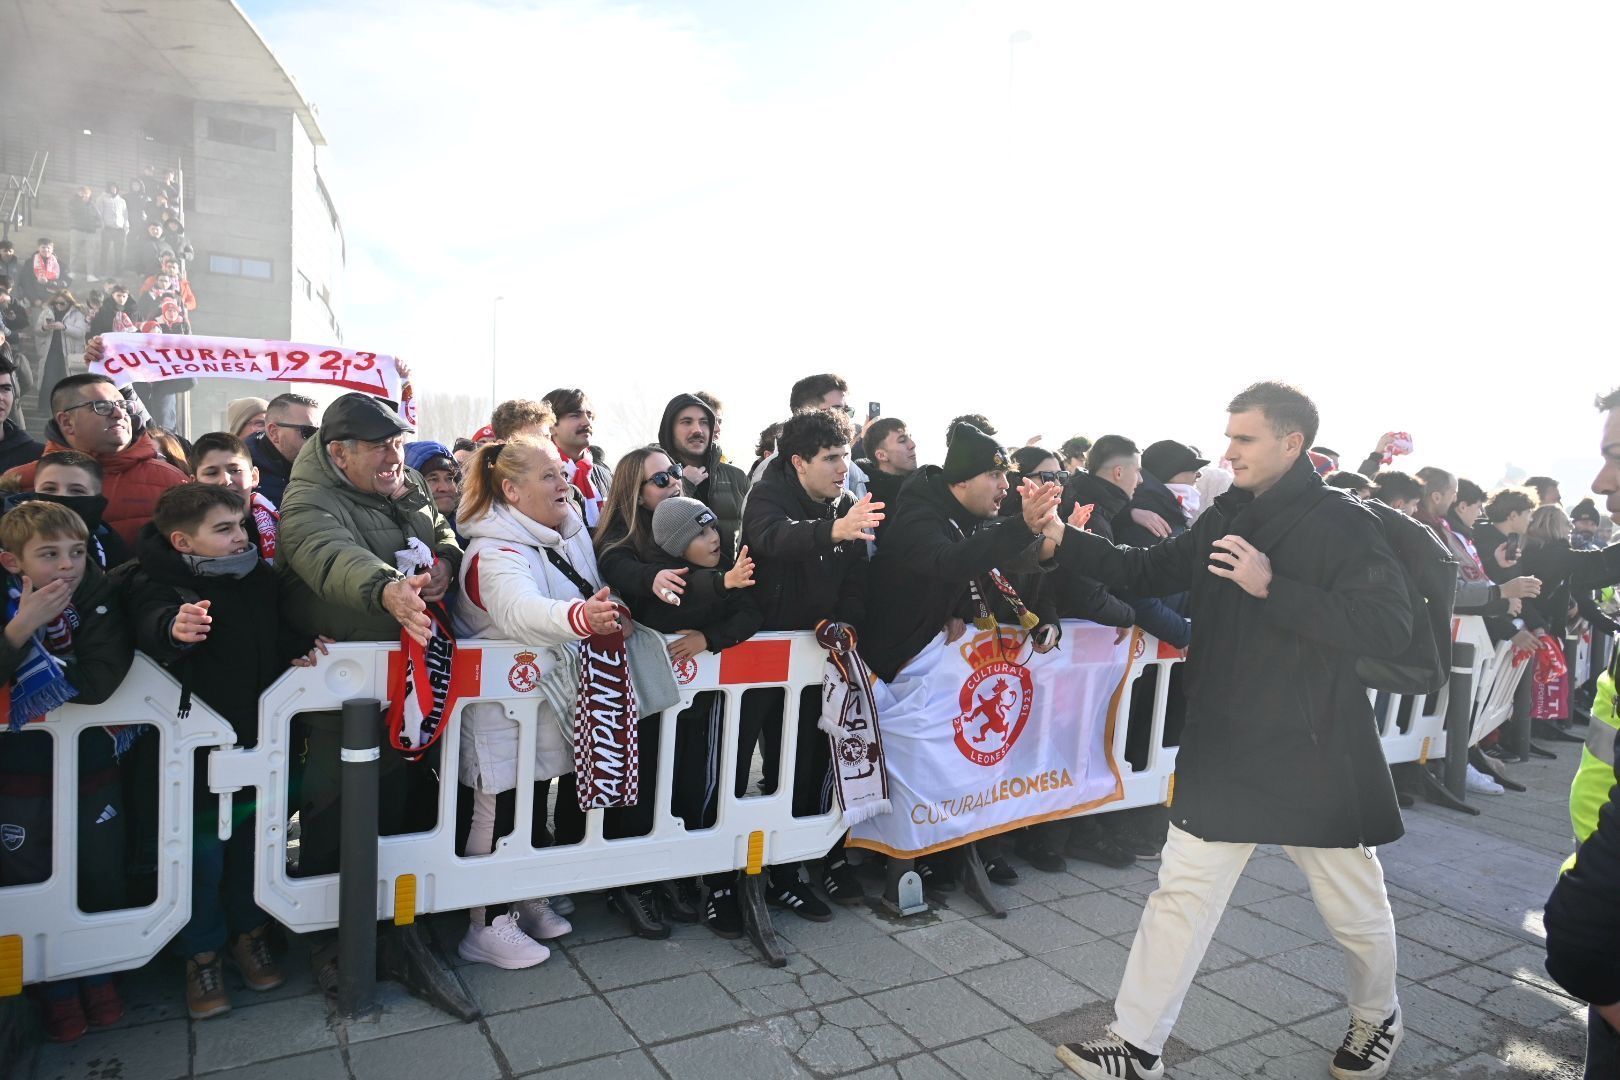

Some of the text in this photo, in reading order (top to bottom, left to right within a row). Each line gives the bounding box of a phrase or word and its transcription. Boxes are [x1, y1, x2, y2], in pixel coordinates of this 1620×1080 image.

[104, 348, 257, 374] CULTURAL
[159, 361, 263, 377] LEONESA
[264, 350, 377, 371] 1923
[967, 663, 1024, 690] CULTURAL
[1020, 688, 1032, 717] 1923
[587, 642, 625, 809] RAMPANTE
[970, 742, 1011, 764] LEONESA
